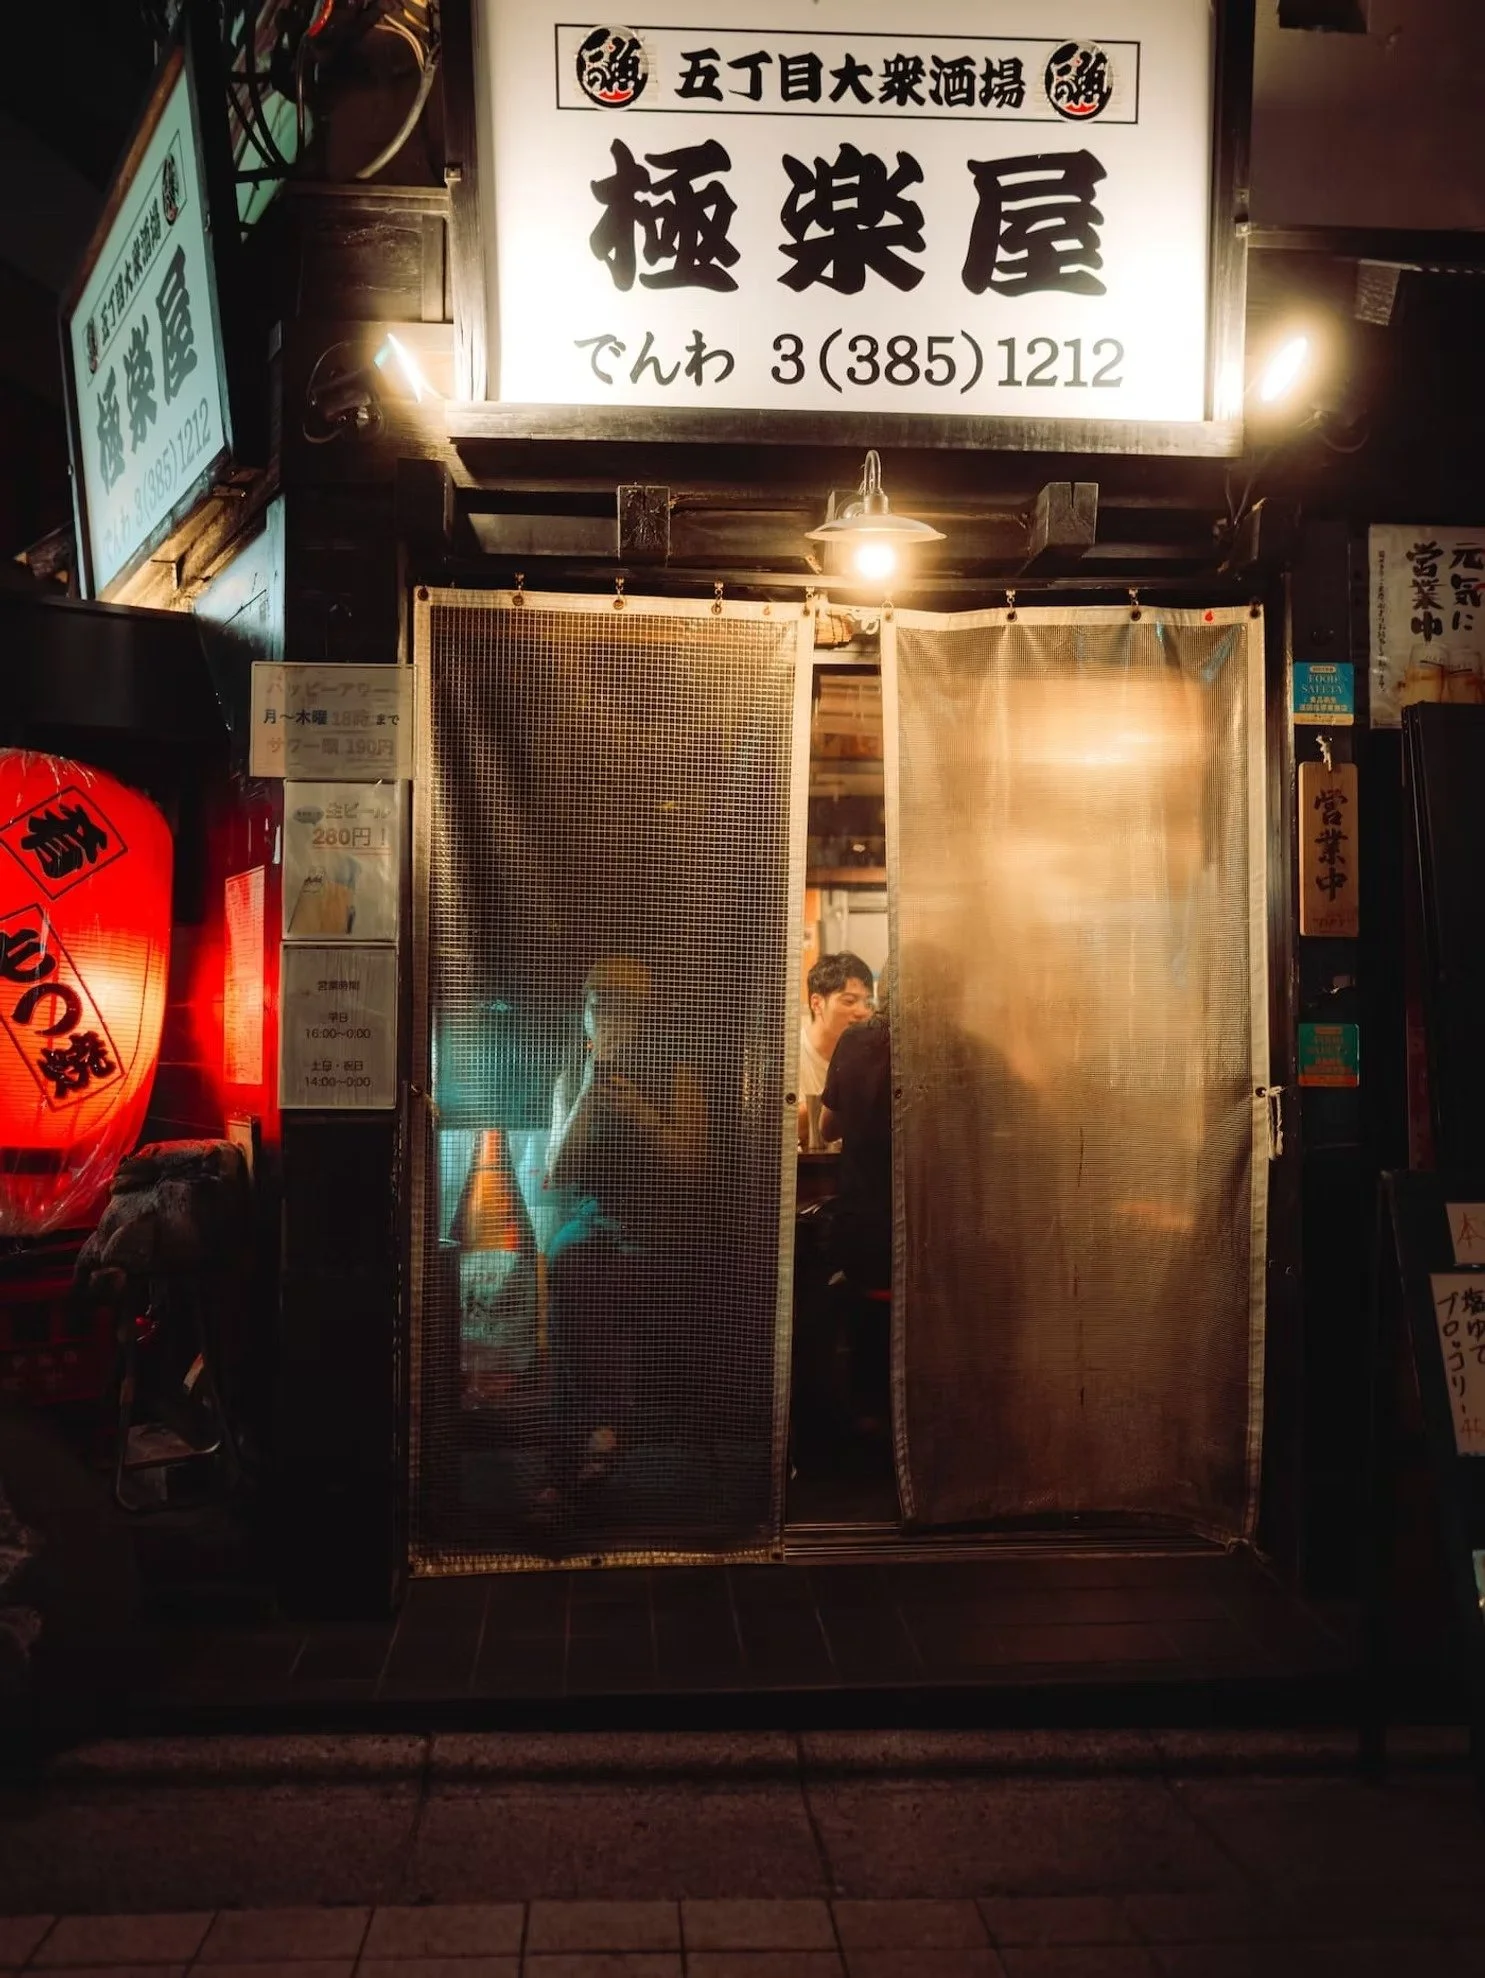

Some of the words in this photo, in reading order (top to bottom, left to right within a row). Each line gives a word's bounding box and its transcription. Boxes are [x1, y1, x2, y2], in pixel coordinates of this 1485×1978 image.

[674, 46, 1027, 110] 五丁目大衆酒場
[589, 138, 1109, 297] 極楽屋
[100, 197, 162, 346] 五丁目大衆酒場
[97, 244, 200, 496] 極楽屋
[573, 329, 736, 387] でんわ
[770, 328, 1125, 394] 3(385)1212
[1405, 540, 1447, 642] 営業中
[1449, 541, 1485, 632] 元気に
